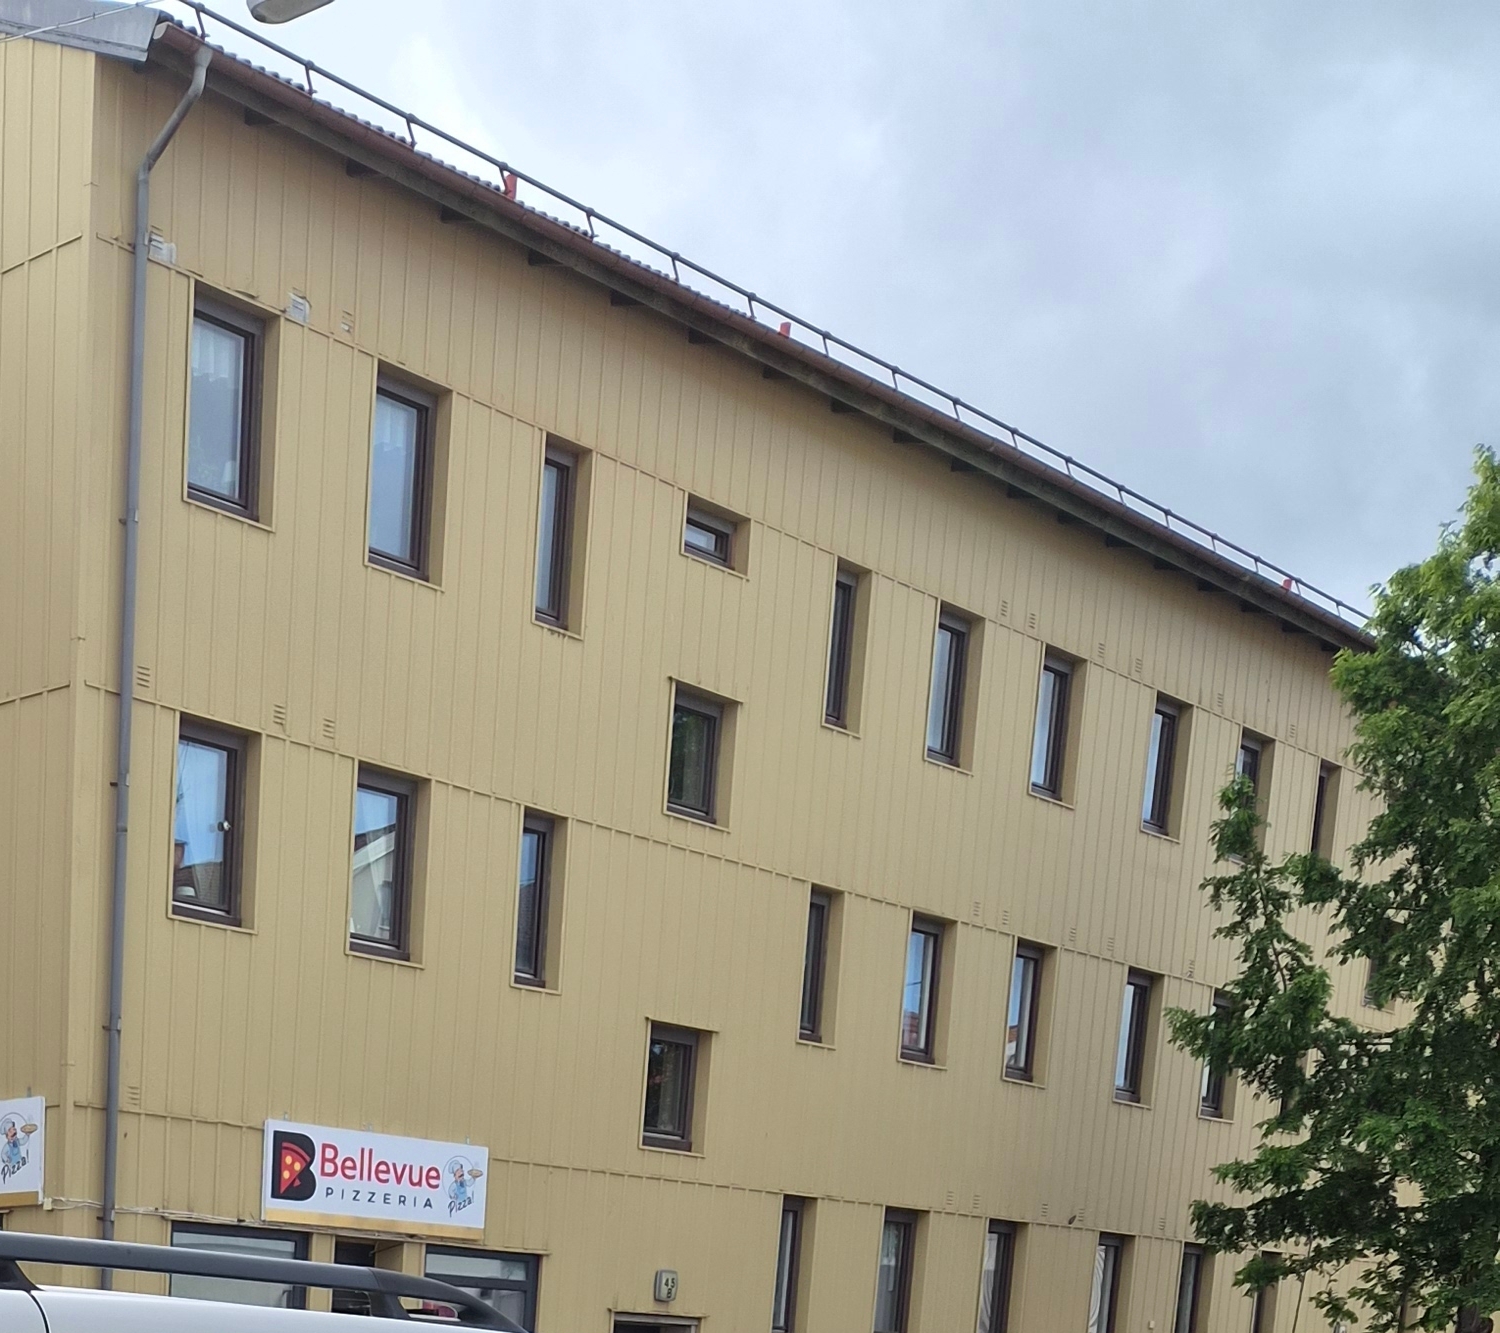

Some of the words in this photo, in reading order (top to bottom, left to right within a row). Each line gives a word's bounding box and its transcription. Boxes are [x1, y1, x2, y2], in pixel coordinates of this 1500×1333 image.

[0, 1149, 30, 1184] Pizza!
[320, 1143, 441, 1190] Bellevue
[325, 1186, 433, 1209] PIZZERIA
